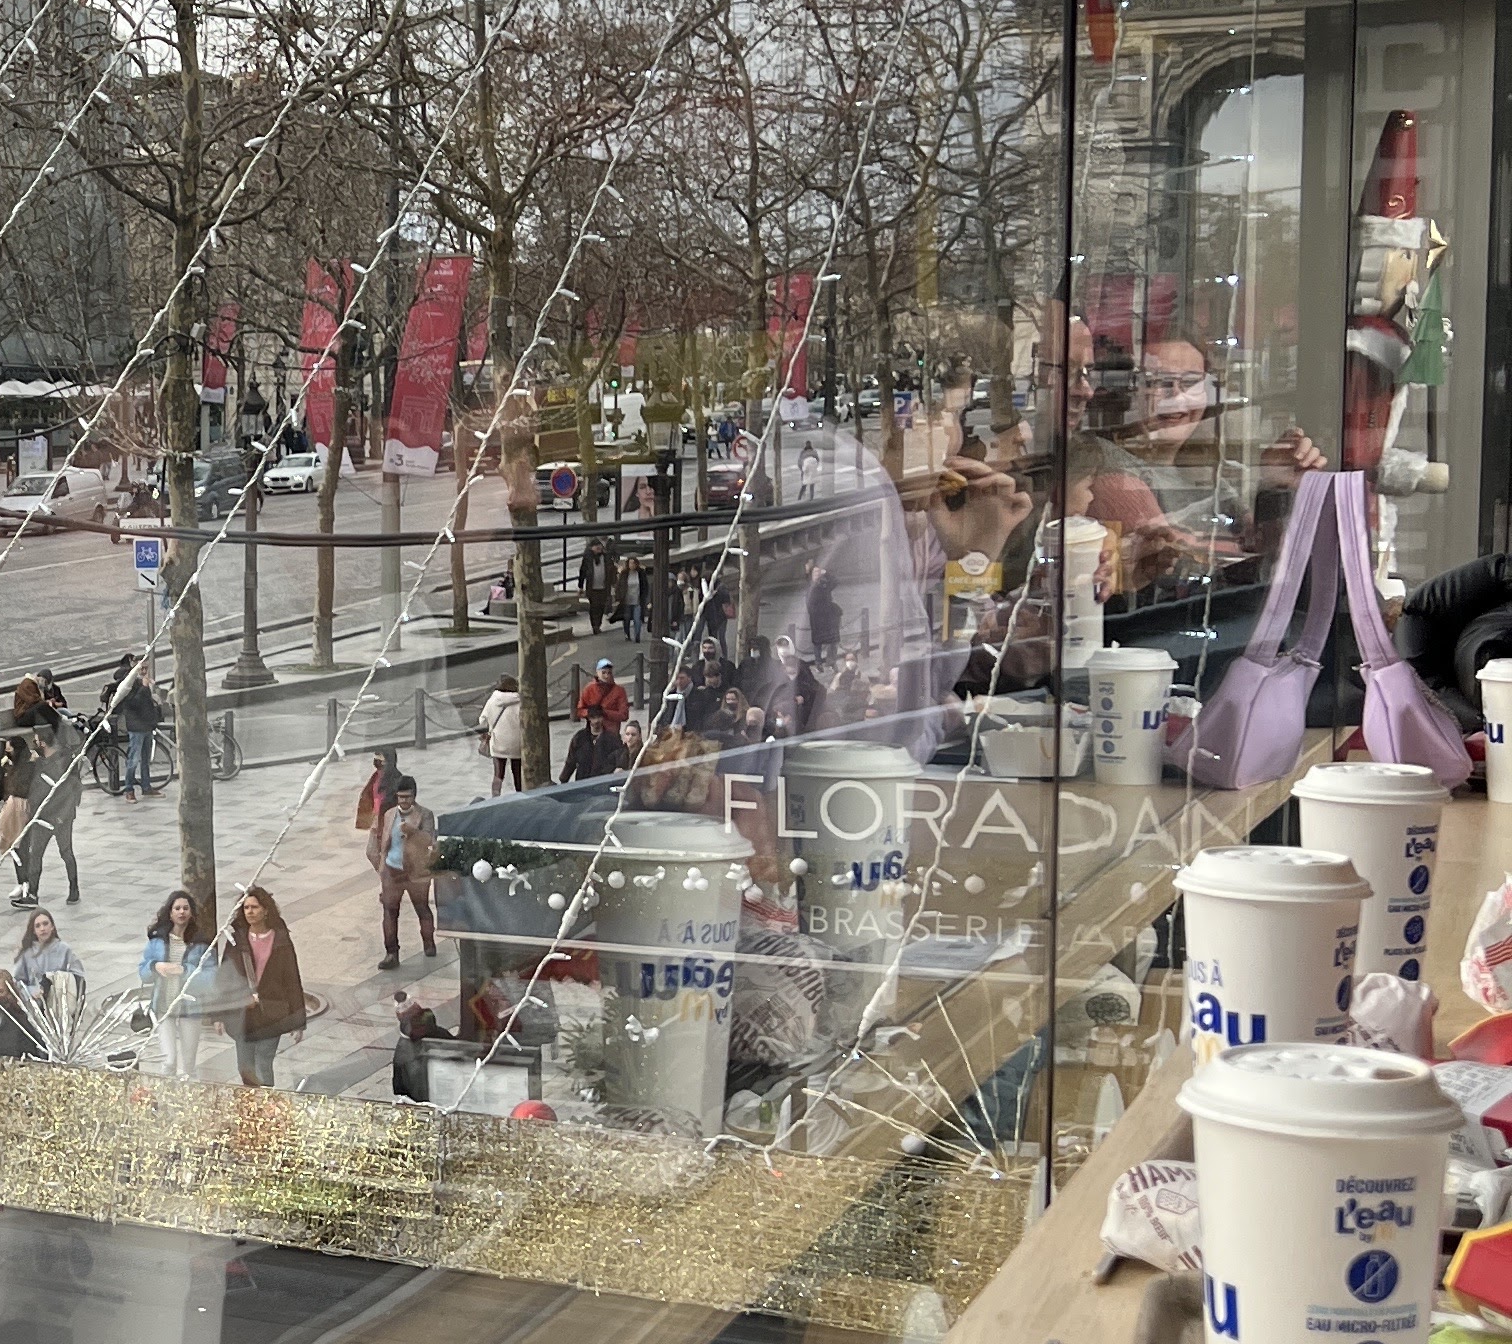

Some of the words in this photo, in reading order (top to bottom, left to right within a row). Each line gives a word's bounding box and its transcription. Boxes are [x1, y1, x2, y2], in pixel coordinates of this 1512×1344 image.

[724, 773, 1038, 853] FLORA
[808, 906, 1046, 949] BRASSERIE
[1189, 991, 1267, 1047] au
[1336, 1175, 1417, 1193] DÉCOUVREZ
[1335, 1197, 1414, 1235] L'eau
